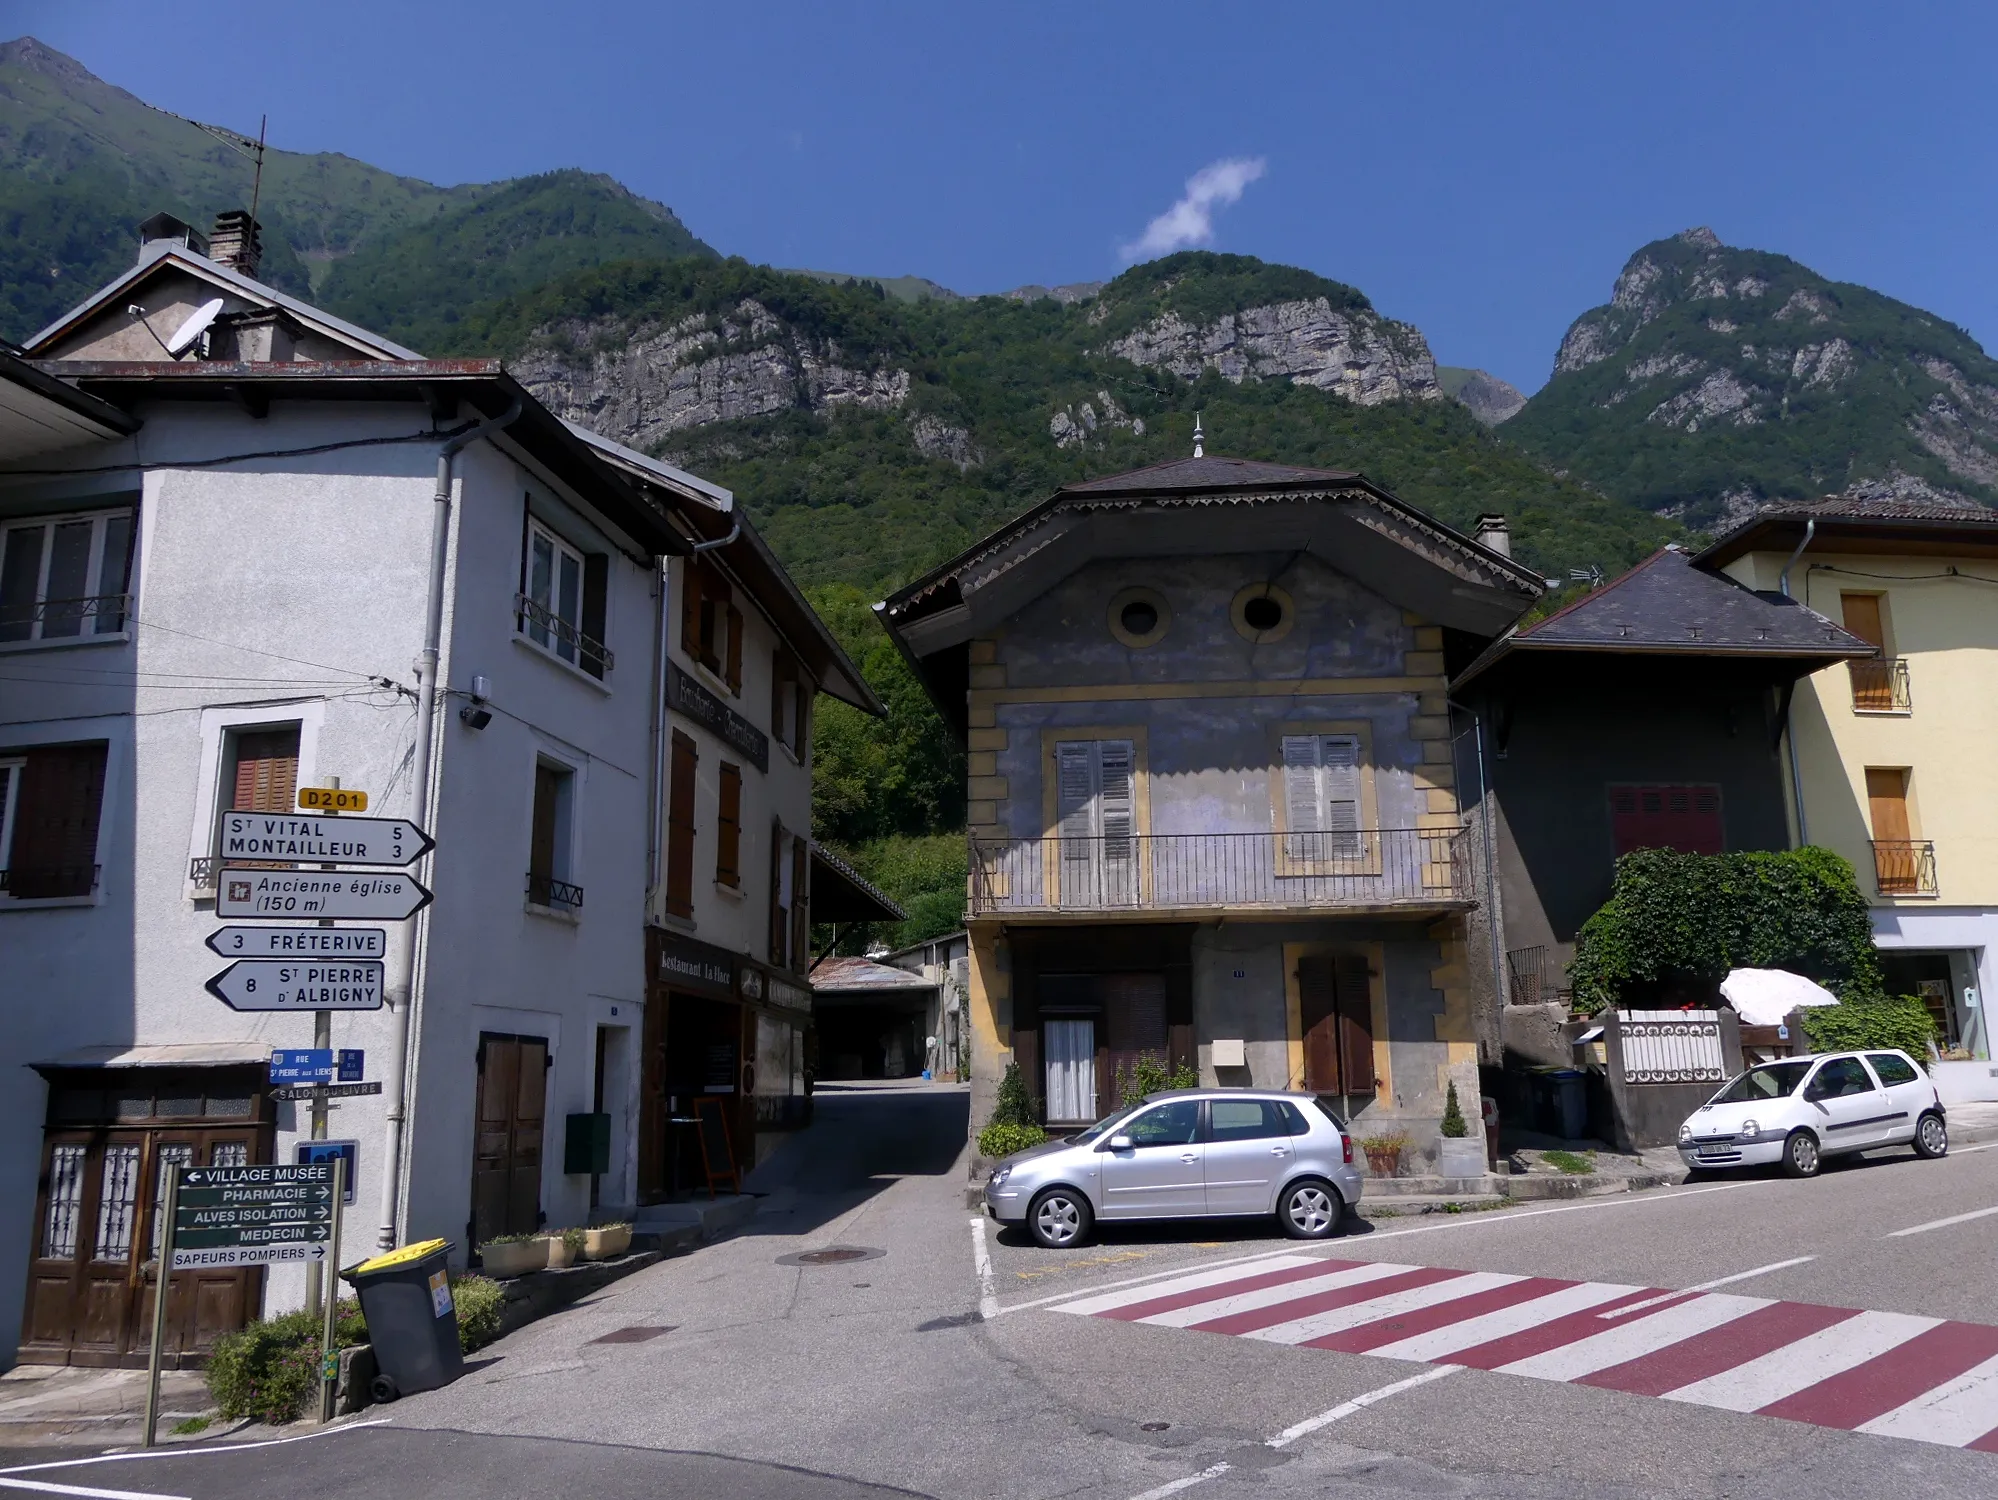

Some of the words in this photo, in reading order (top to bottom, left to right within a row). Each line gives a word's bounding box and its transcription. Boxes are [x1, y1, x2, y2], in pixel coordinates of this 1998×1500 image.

[308, 792, 358, 807] D201
[265, 821, 324, 837] VITAL
[392, 827, 402, 840] 5
[229, 838, 367, 857] MONTAILLEUR
[392, 846, 402, 858] 3
[257, 878, 341, 893] Ancienne
[350, 879, 402, 896] église
[256, 896, 296, 911] (150
[303, 897, 326, 912] m)
[233, 935, 244, 949] 3
[270, 933, 377, 950] FRÉTERIVE
[661, 950, 701, 977] Restaurant
[308, 968, 375, 983] PIERRE
[246, 978, 257, 992] 8
[296, 988, 375, 1003] ALBIGNY
[295, 1055, 309, 1063] RUE
[279, 1068, 299, 1077] PIERRE
[315, 1067, 332, 1076] LIENS
[279, 1088, 318, 1100] SALON
[342, 1083, 376, 1095] LIVRE
[206, 1169, 270, 1183] VILLAGE
[274, 1165, 327, 1181] MUSÉE
[223, 1188, 307, 1201] PHARMACIE
[194, 1211, 235, 1223] ALVES
[239, 1208, 307, 1222] ISOLATION
[239, 1228, 305, 1241] MEDECIN
[175, 1251, 236, 1265] SAPEURS
[240, 1248, 305, 1262] POMPIERS
